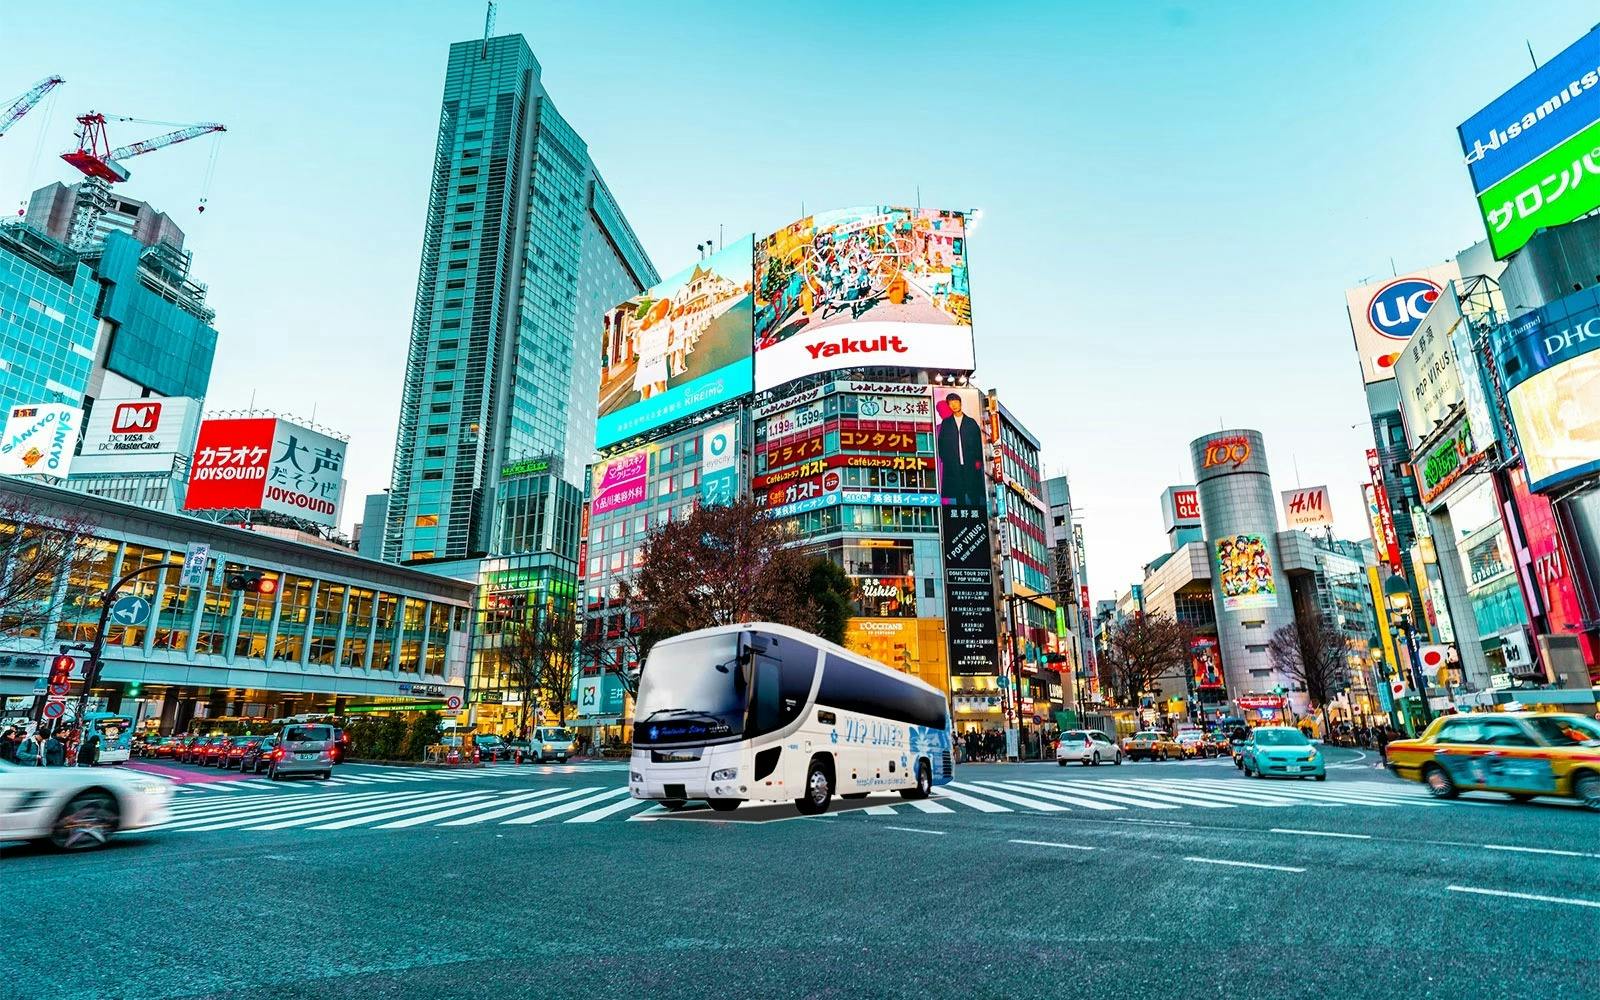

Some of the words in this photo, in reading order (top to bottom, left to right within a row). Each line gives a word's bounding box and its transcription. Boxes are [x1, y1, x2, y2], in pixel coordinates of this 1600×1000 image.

[1463, 66, 1600, 165] Hisamits
[805, 335, 908, 359] Yakult
[1544, 317, 1600, 356] DHC
[684, 383, 724, 407] KIREIMO
[850, 383, 928, 394] しゃぶしゃぶバイキング
[117, 407, 155, 429] DC
[883, 399, 929, 415] しゃぶ葉
[108, 434, 123, 442] DC
[123, 433, 143, 442] VISA
[756, 425, 767, 437] 9F
[841, 432, 914, 448] コンタクト
[99, 442, 113, 451] DC
[113, 441, 161, 450] MasterCard
[197, 445, 268, 467] カラオケ
[273, 435, 343, 475] 大声
[769, 438, 823, 466] プライス
[1202, 443, 1250, 470] 109
[193, 466, 266, 481] JOYSOUND
[800, 460, 828, 478] ガスト
[893, 456, 927, 470] ガスト
[269, 466, 337, 499] だそうぜ
[786, 481, 820, 503] ガスト
[265, 485, 336, 516] JOYSOUND
[756, 494, 768, 507] 7F
[1177, 494, 1198, 505] UN
[1288, 490, 1323, 514] H&M
[950, 509, 979, 518] 星野源
